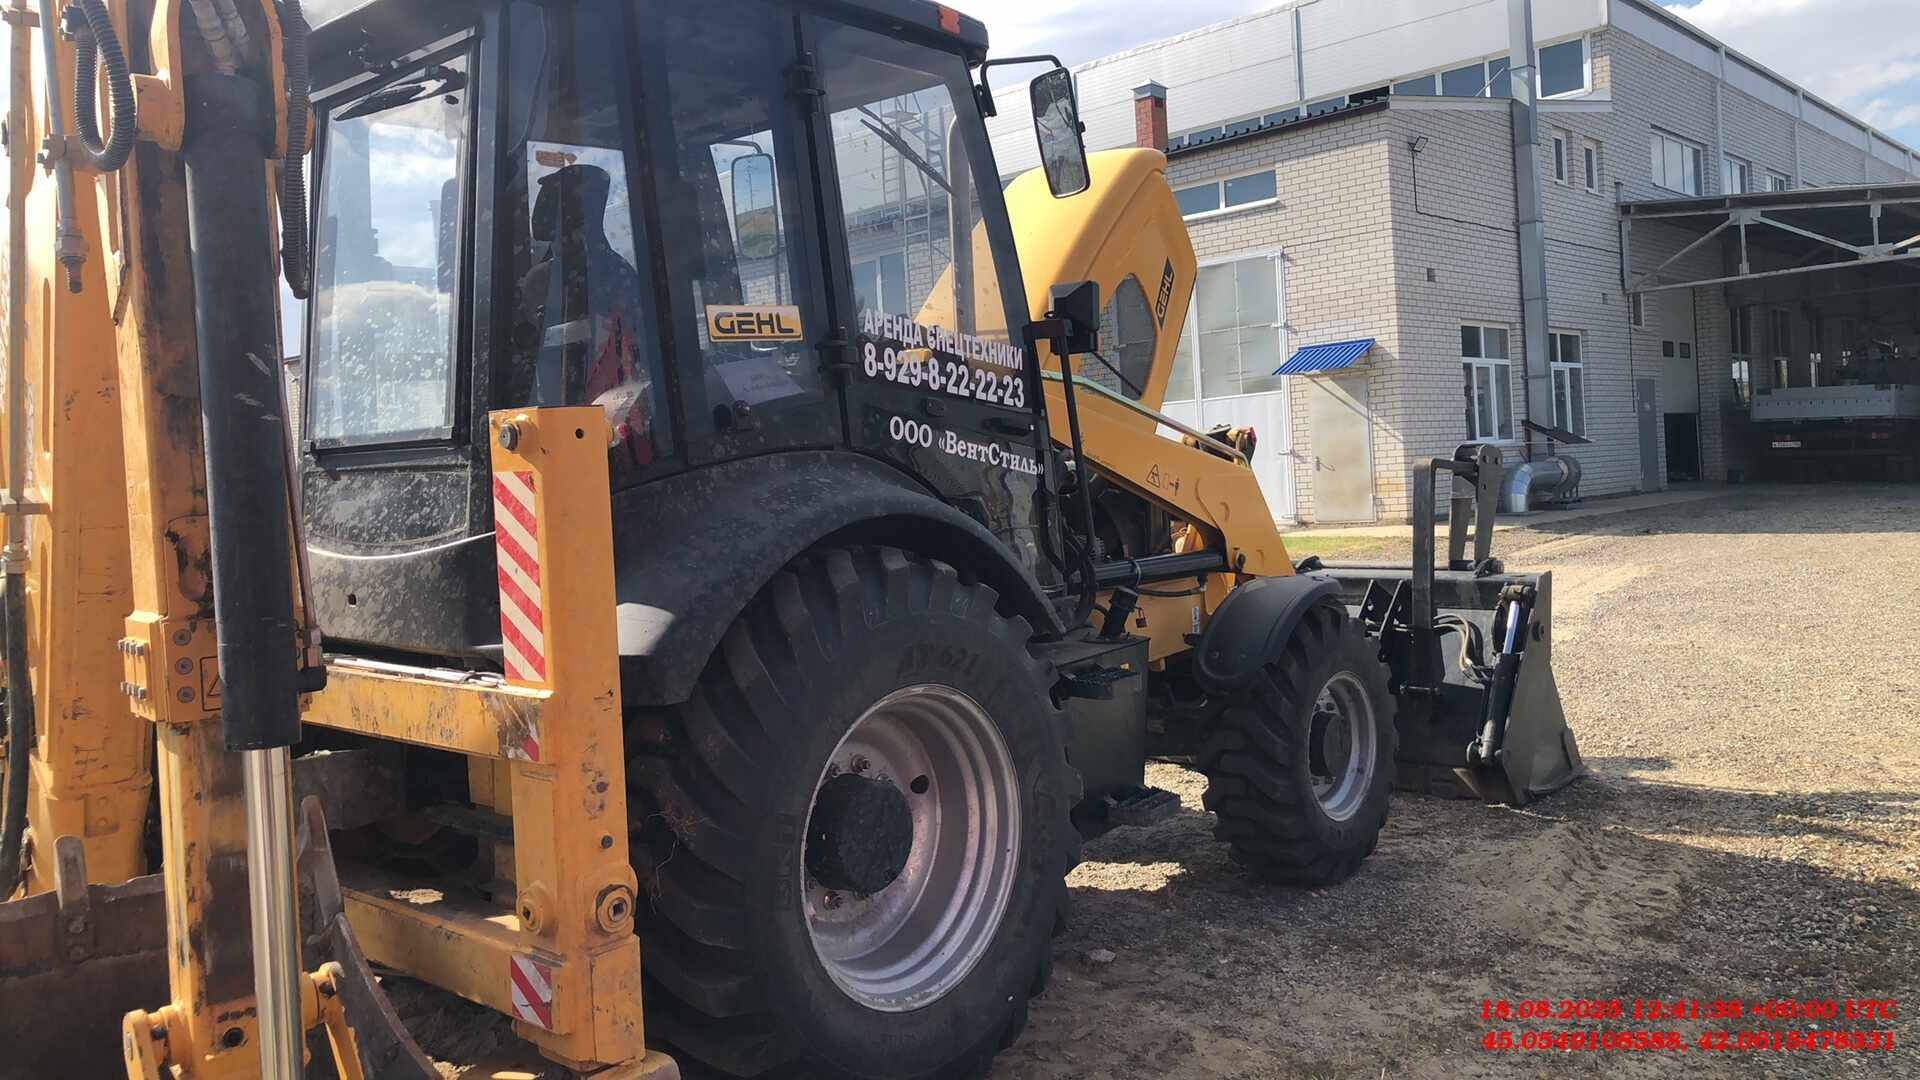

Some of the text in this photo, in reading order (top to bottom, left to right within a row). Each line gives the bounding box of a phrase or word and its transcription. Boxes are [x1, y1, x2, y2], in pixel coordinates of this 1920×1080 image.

[714, 311, 795, 334] GEHL
[1155, 271, 1175, 319] GEHL
[864, 308, 1024, 371] АРЕНДА СПЕЦТЕХНИКИ
[864, 342, 1025, 409] 8-929-8-22-22-23
[889, 415, 1045, 476] ООО «ВентСтиль»
